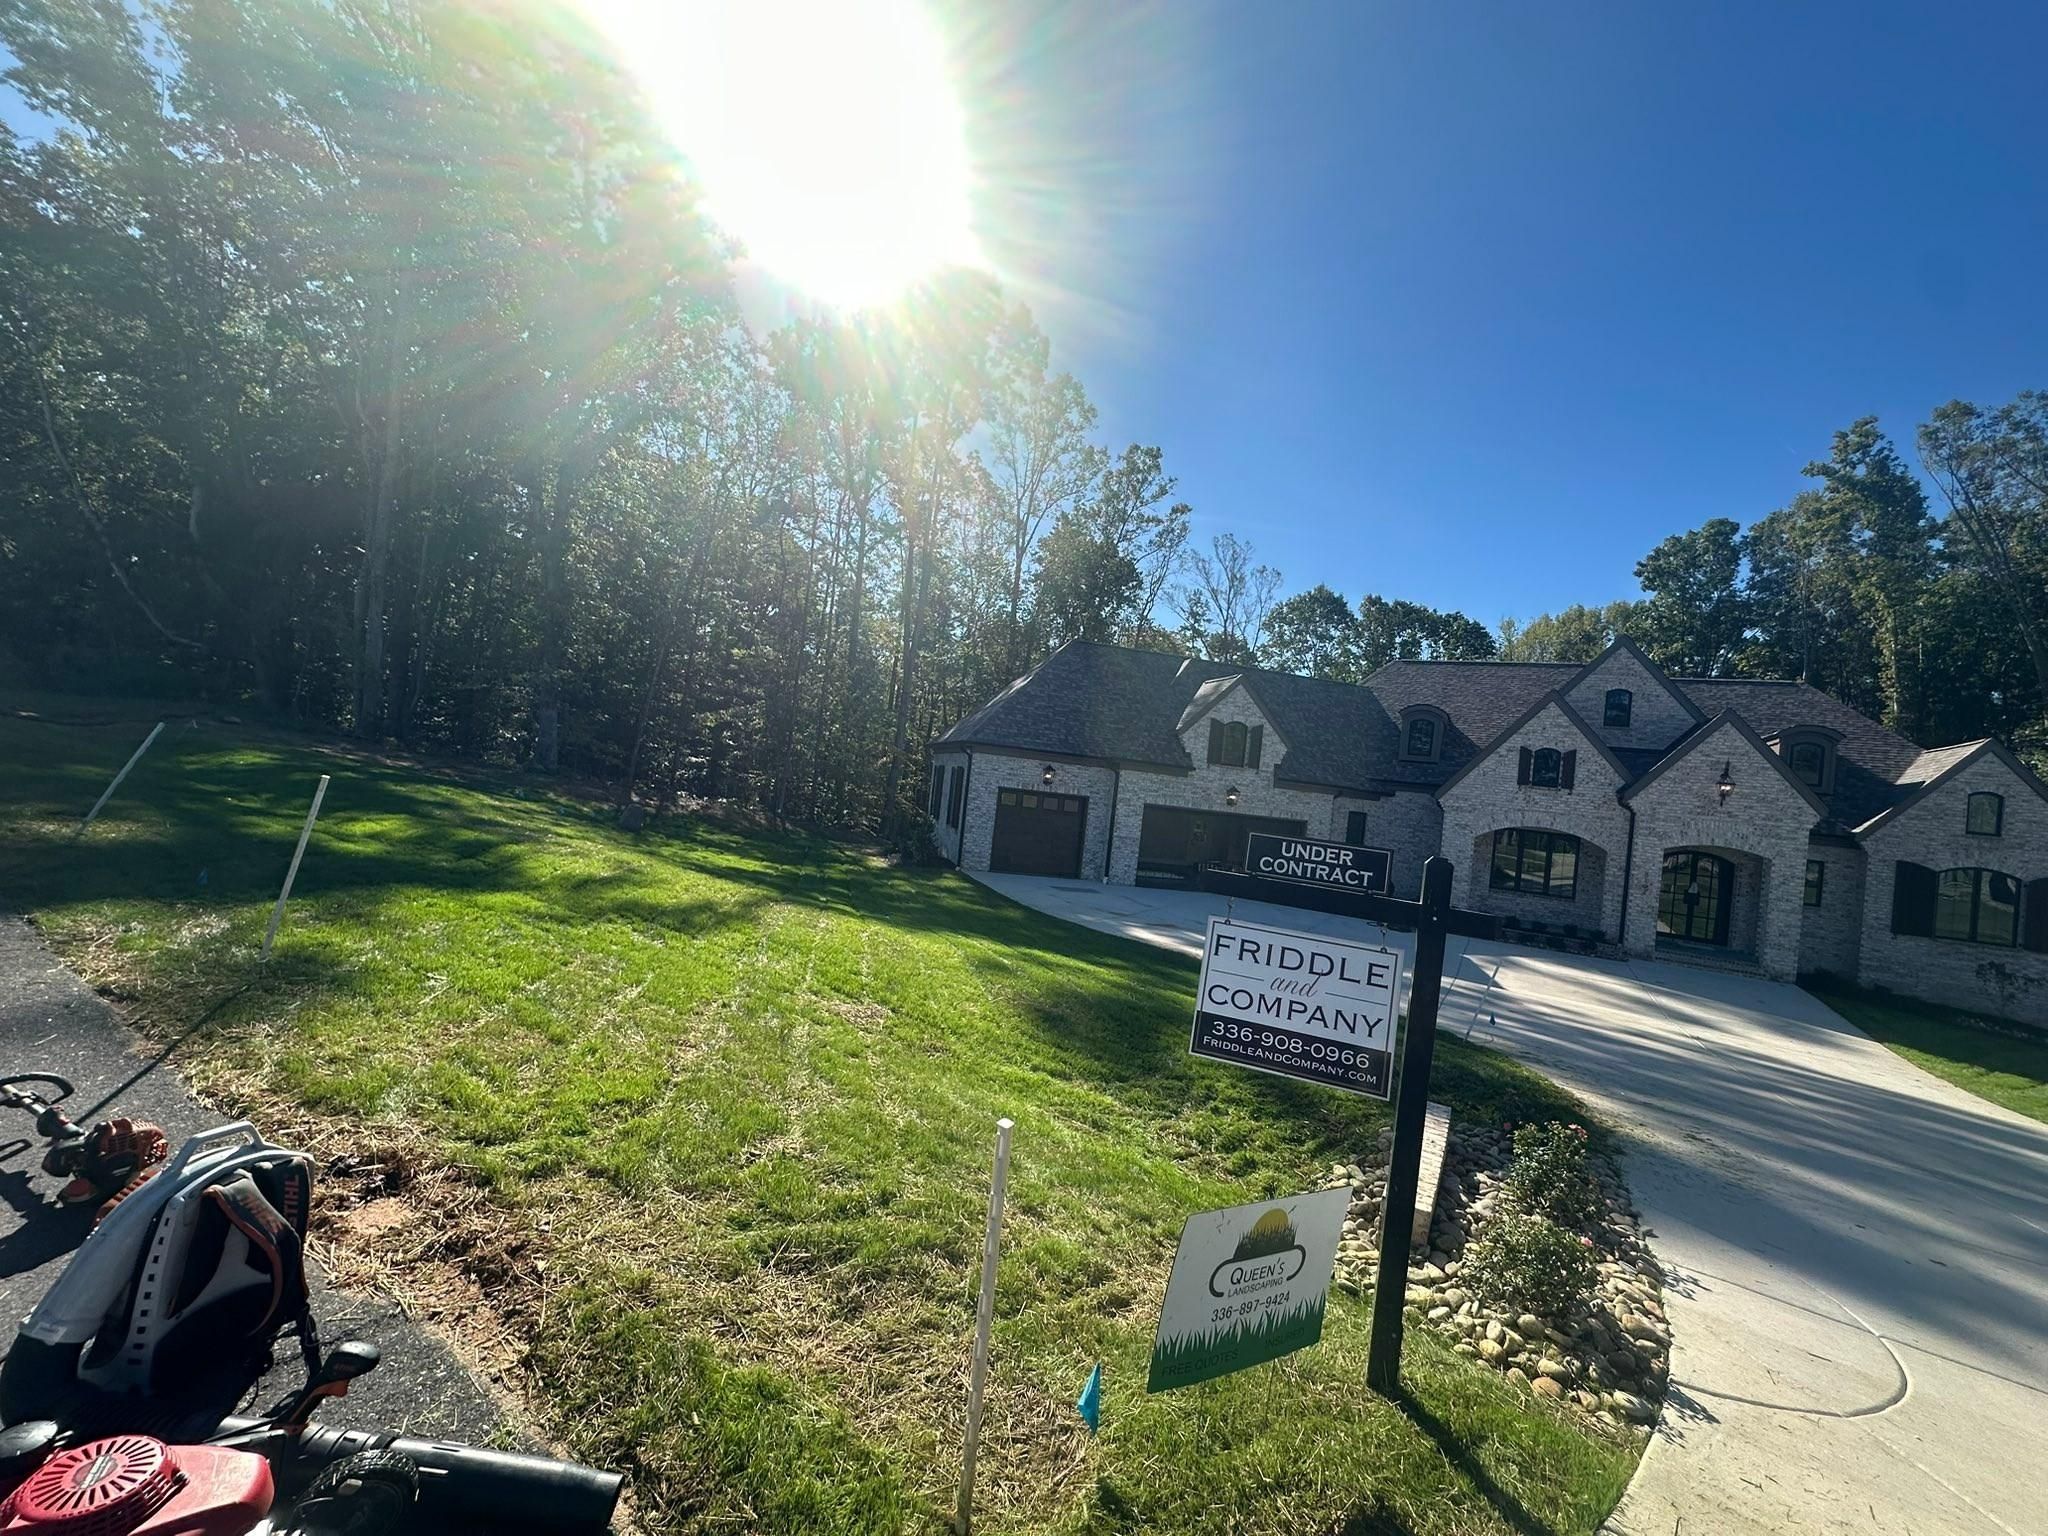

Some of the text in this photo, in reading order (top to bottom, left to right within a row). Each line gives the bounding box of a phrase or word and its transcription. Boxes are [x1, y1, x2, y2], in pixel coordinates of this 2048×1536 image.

[1281, 841, 1353, 866] UNDER
[1259, 856, 1373, 887] CONTRACT
[1213, 934, 1390, 990] FRIDDLE
[1270, 968, 1325, 998] and
[1207, 984, 1383, 1038] COMPANY
[1212, 1021, 1370, 1069] 336-908-0966
[1230, 1257, 1286, 1286] QUEEN'S
[1227, 1277, 1284, 1298] LANDSCAPING
[1211, 1291, 1290, 1322] 336-897-9424
[1161, 1349, 1239, 1377] FREE QUOTES
